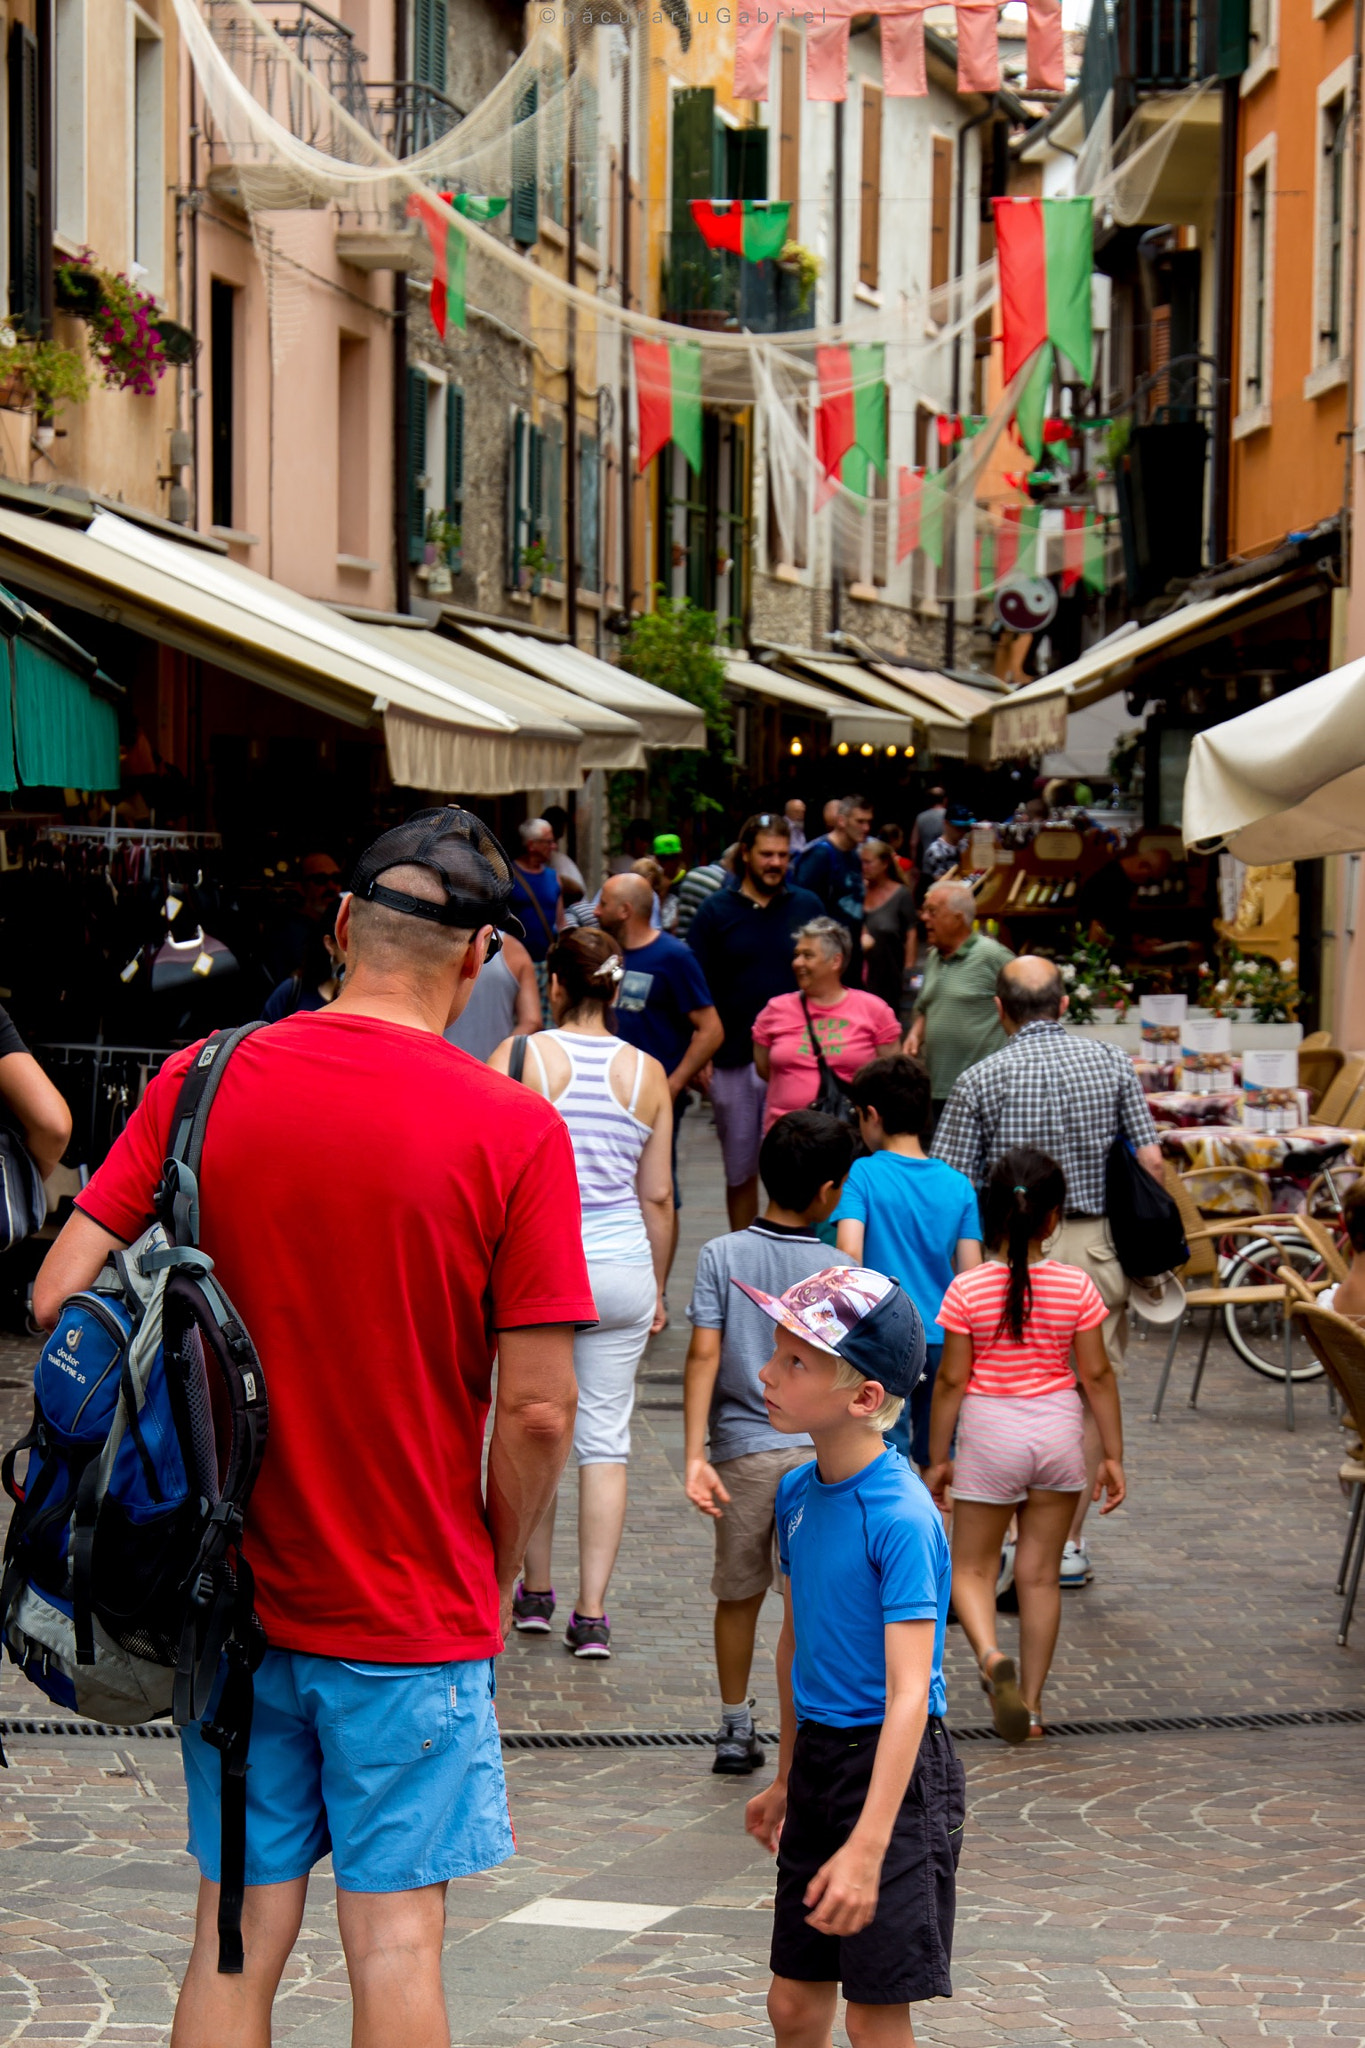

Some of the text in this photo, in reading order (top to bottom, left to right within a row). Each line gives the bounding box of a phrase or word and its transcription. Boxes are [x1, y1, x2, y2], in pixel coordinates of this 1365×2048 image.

[48, 1353, 86, 1384] TRANS ALPINE 25
[57, 1346, 80, 1367] deuter
